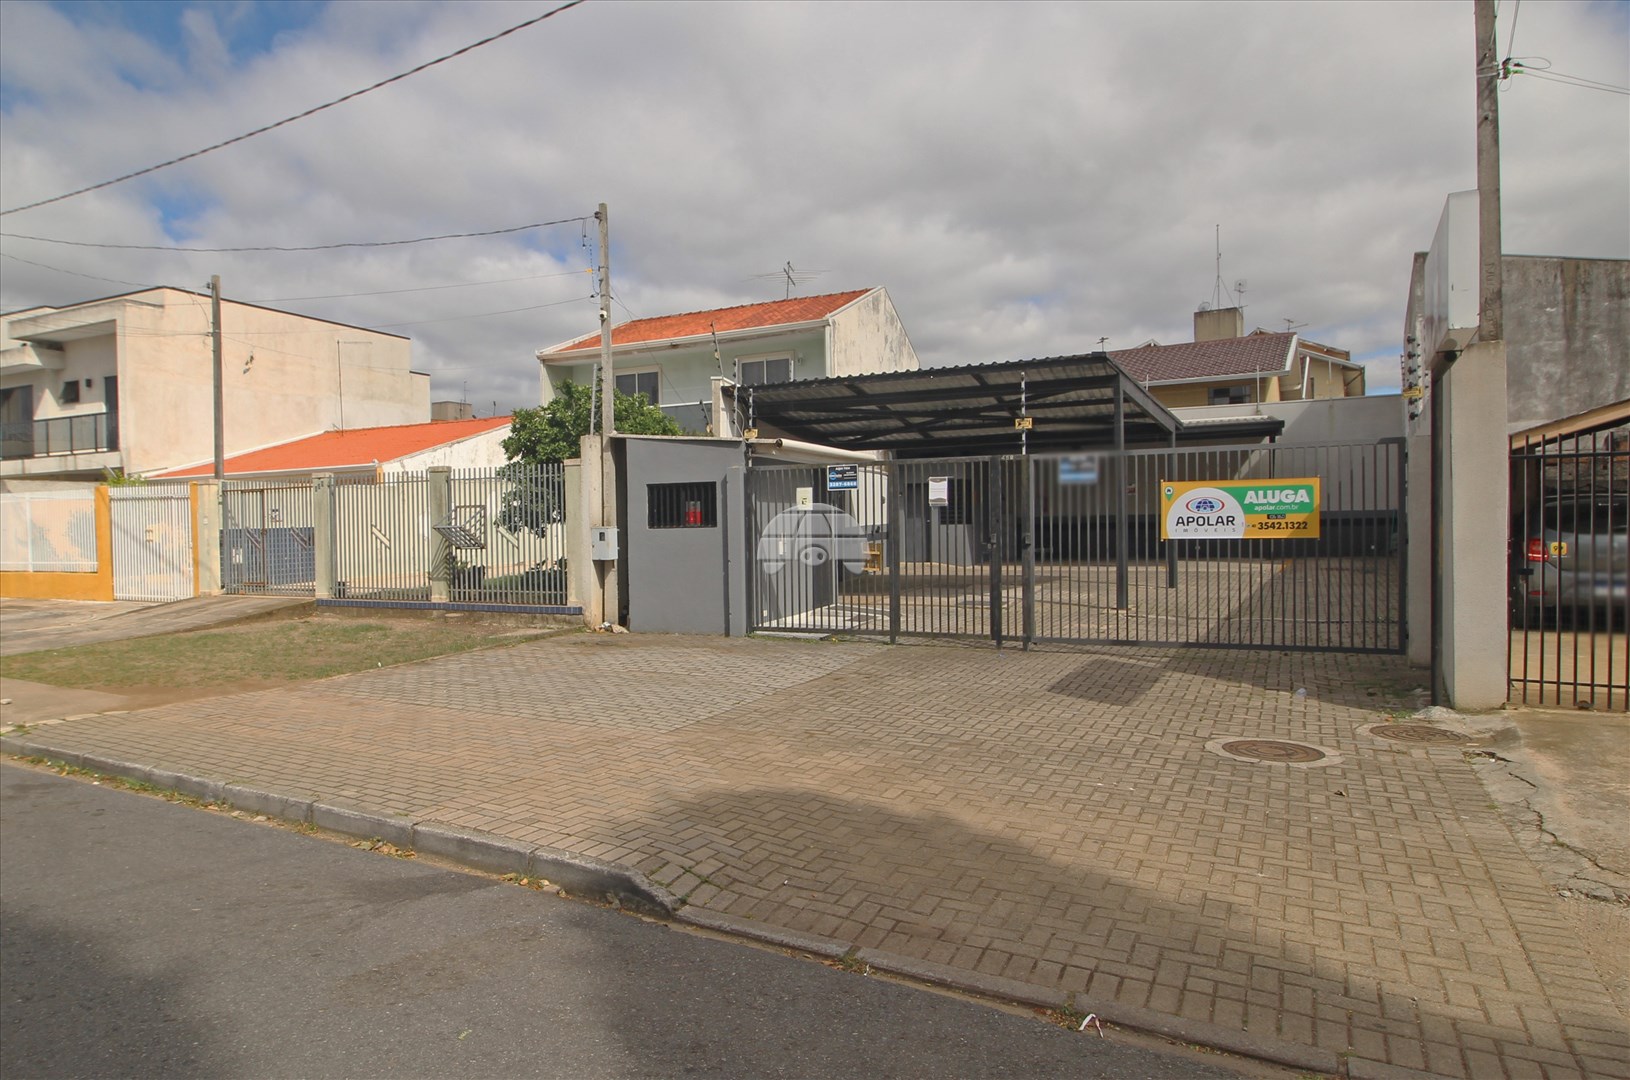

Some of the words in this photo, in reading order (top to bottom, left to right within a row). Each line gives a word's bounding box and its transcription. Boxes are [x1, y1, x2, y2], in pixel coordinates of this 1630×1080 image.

[1244, 489, 1310, 504] ALUGA
[1175, 515, 1236, 527] APOLAR
[1257, 521, 1308, 530] 3542.1322
